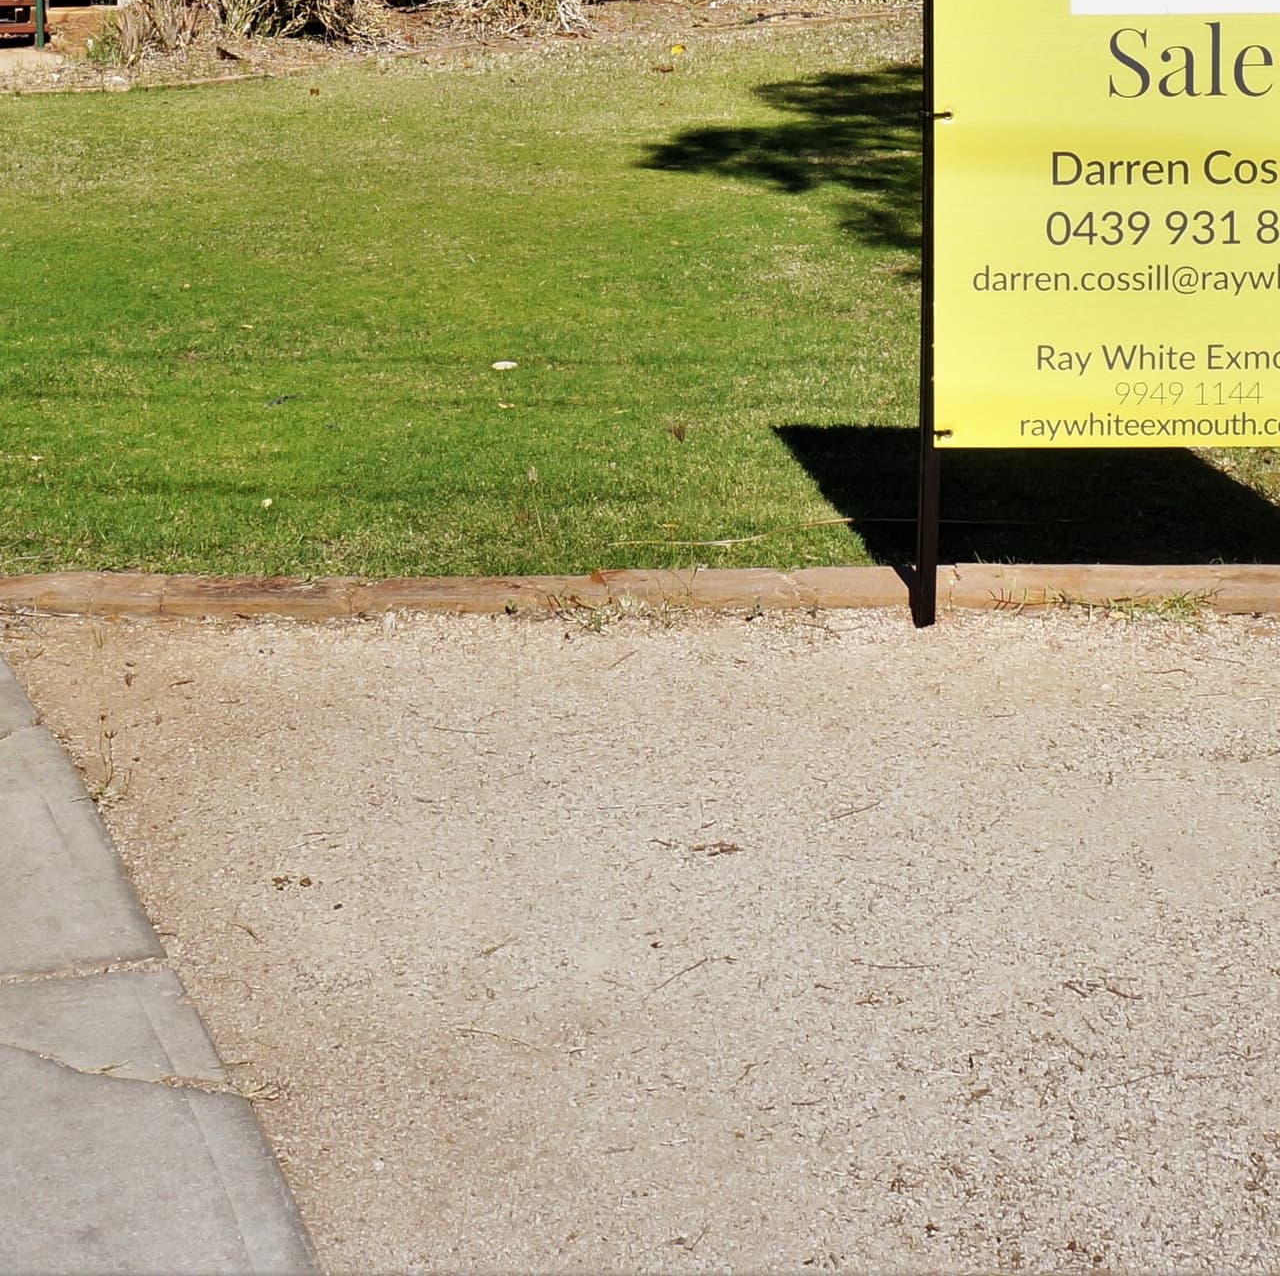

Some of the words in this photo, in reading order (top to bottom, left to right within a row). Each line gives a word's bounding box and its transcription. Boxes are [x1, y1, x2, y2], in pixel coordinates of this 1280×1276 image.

[1108, 21, 1274, 98] Sale
[1052, 151, 1189, 186] Darren
[1046, 210, 1151, 246] 0439
[1165, 210, 1241, 245] 931
[1037, 344, 1093, 377] Ray
[1101, 343, 1196, 371] White
[1114, 381, 1184, 406] 9949
[1195, 381, 1265, 406] 1144
